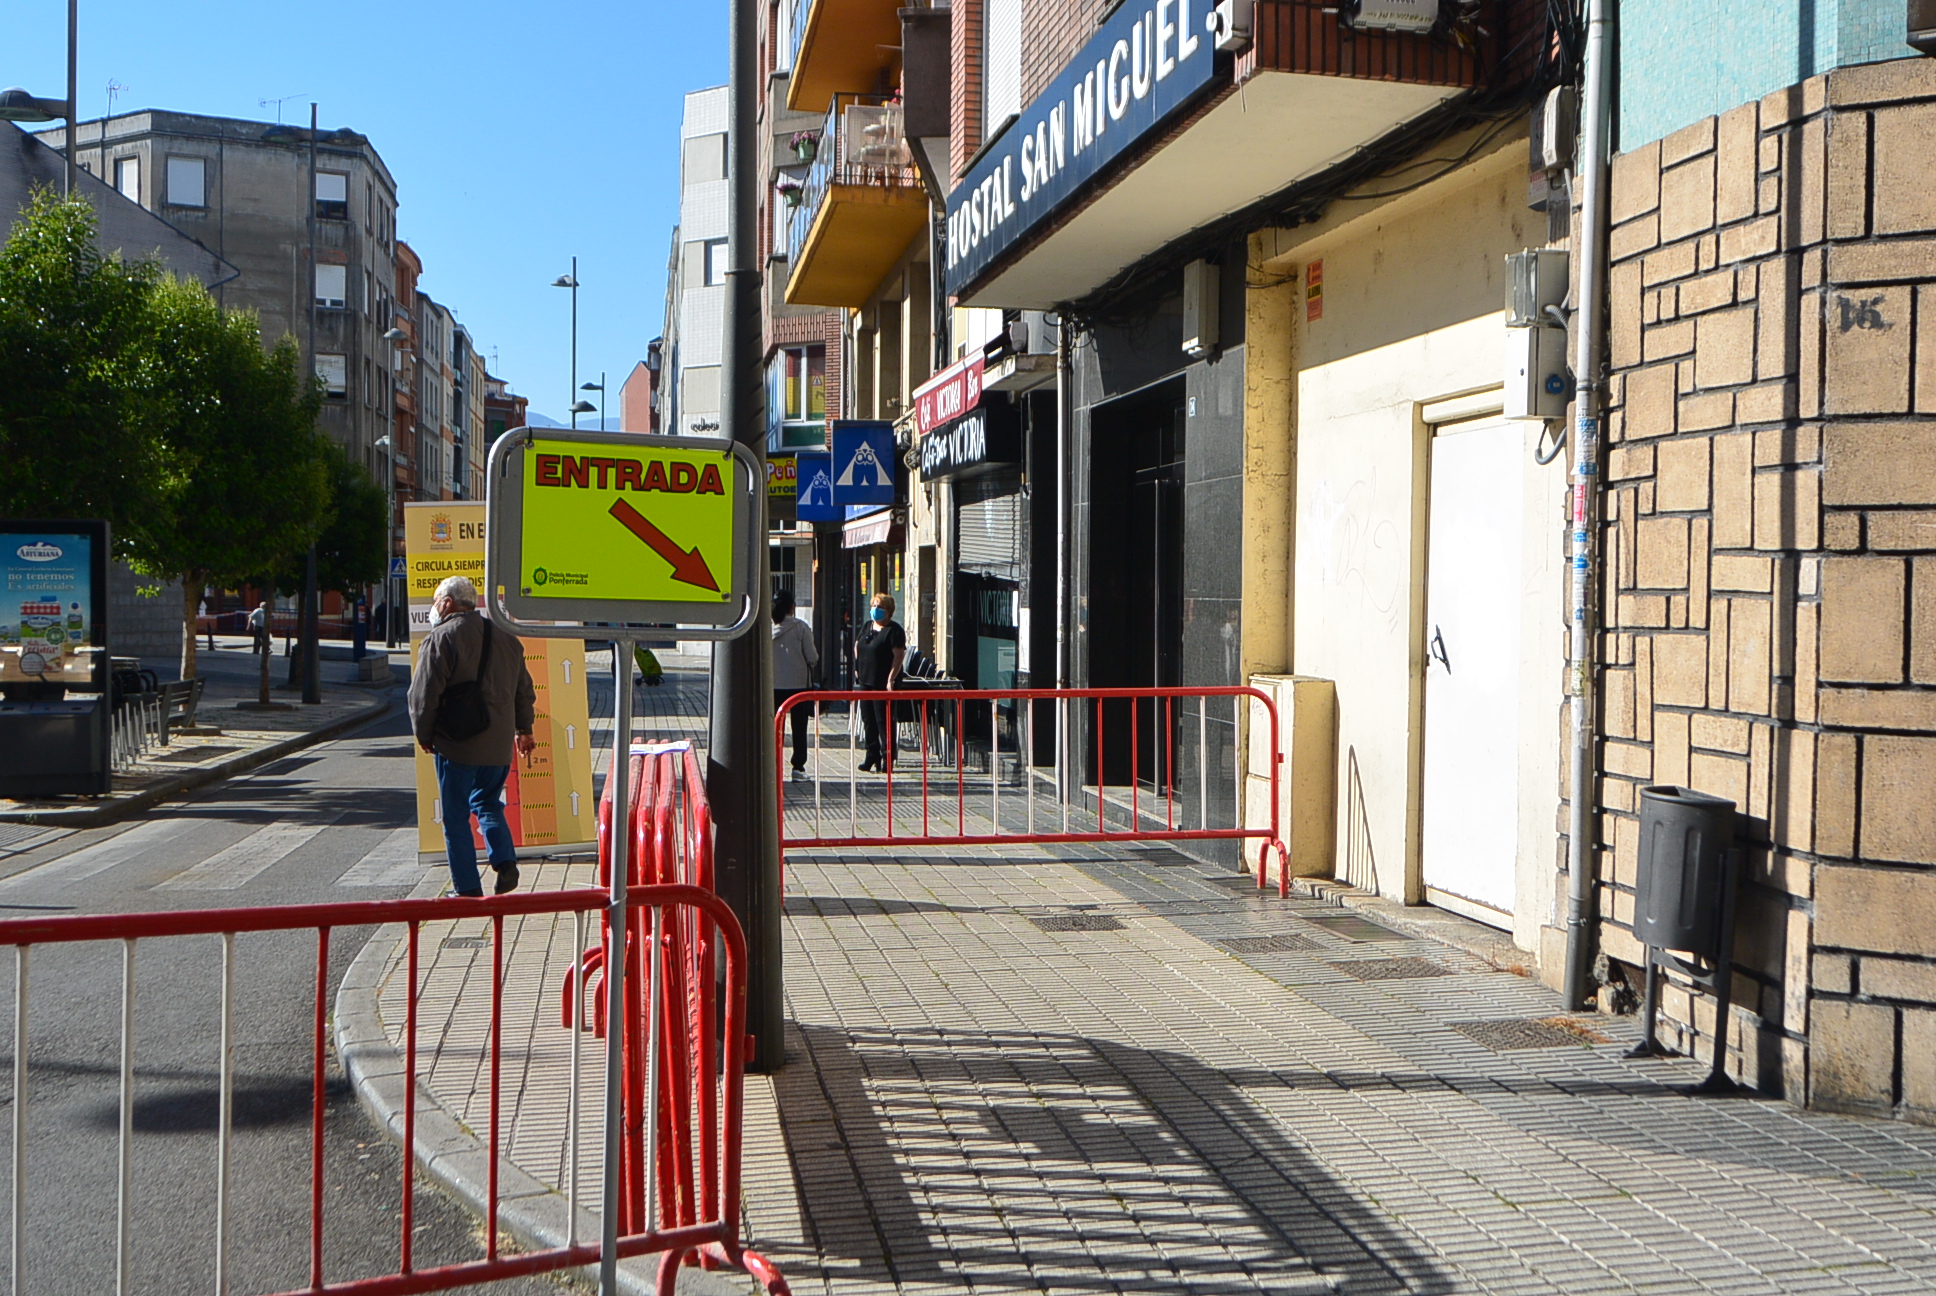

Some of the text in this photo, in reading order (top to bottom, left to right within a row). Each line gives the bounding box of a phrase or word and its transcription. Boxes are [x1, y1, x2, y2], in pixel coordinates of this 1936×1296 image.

[948, 0, 1199, 270] HOSTAL SAN MIGUEL
[936, 378, 961, 421] VICTORIA
[948, 415, 986, 467] VICTORIA
[535, 453, 726, 496] ENTRADA
[459, 522, 475, 539] EN
[416, 560, 453, 571] CIRCULA
[26, 572, 75, 580] tenemos
[549, 576, 588, 586] Ponferrada
[26, 581, 75, 590] artificiales
